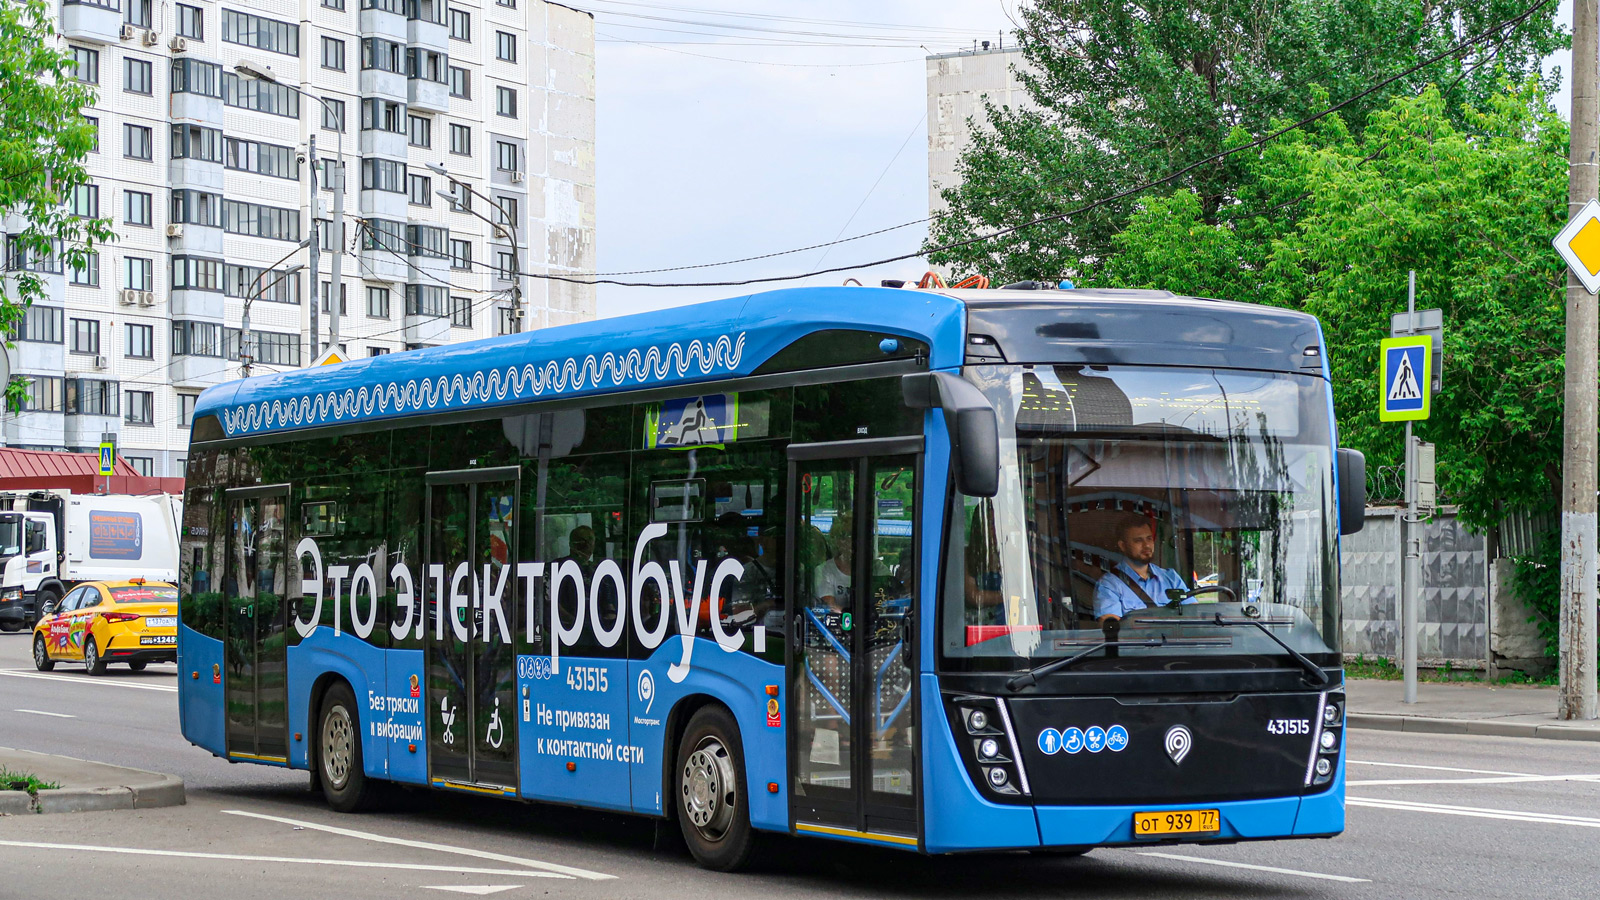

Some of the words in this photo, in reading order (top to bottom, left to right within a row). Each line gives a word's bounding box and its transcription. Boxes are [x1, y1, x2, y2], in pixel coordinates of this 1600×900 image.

[294, 537, 378, 639] Это
[390, 522, 766, 684] электробус.
[566, 666, 608, 692] 431515
[369, 690, 385, 710] Без
[387, 696, 419, 714] тряски
[537, 703, 552, 726] Не
[555, 710, 610, 732] привязан
[1267, 719, 1310, 735] 431515
[371, 721, 375, 736] и
[377, 719, 423, 742] вибраций
[537, 737, 544, 754] к
[546, 738, 613, 760] контактной
[616, 744, 644, 764] сети
[1165, 812, 1193, 831] 939
[1201, 811, 1214, 824] 77
